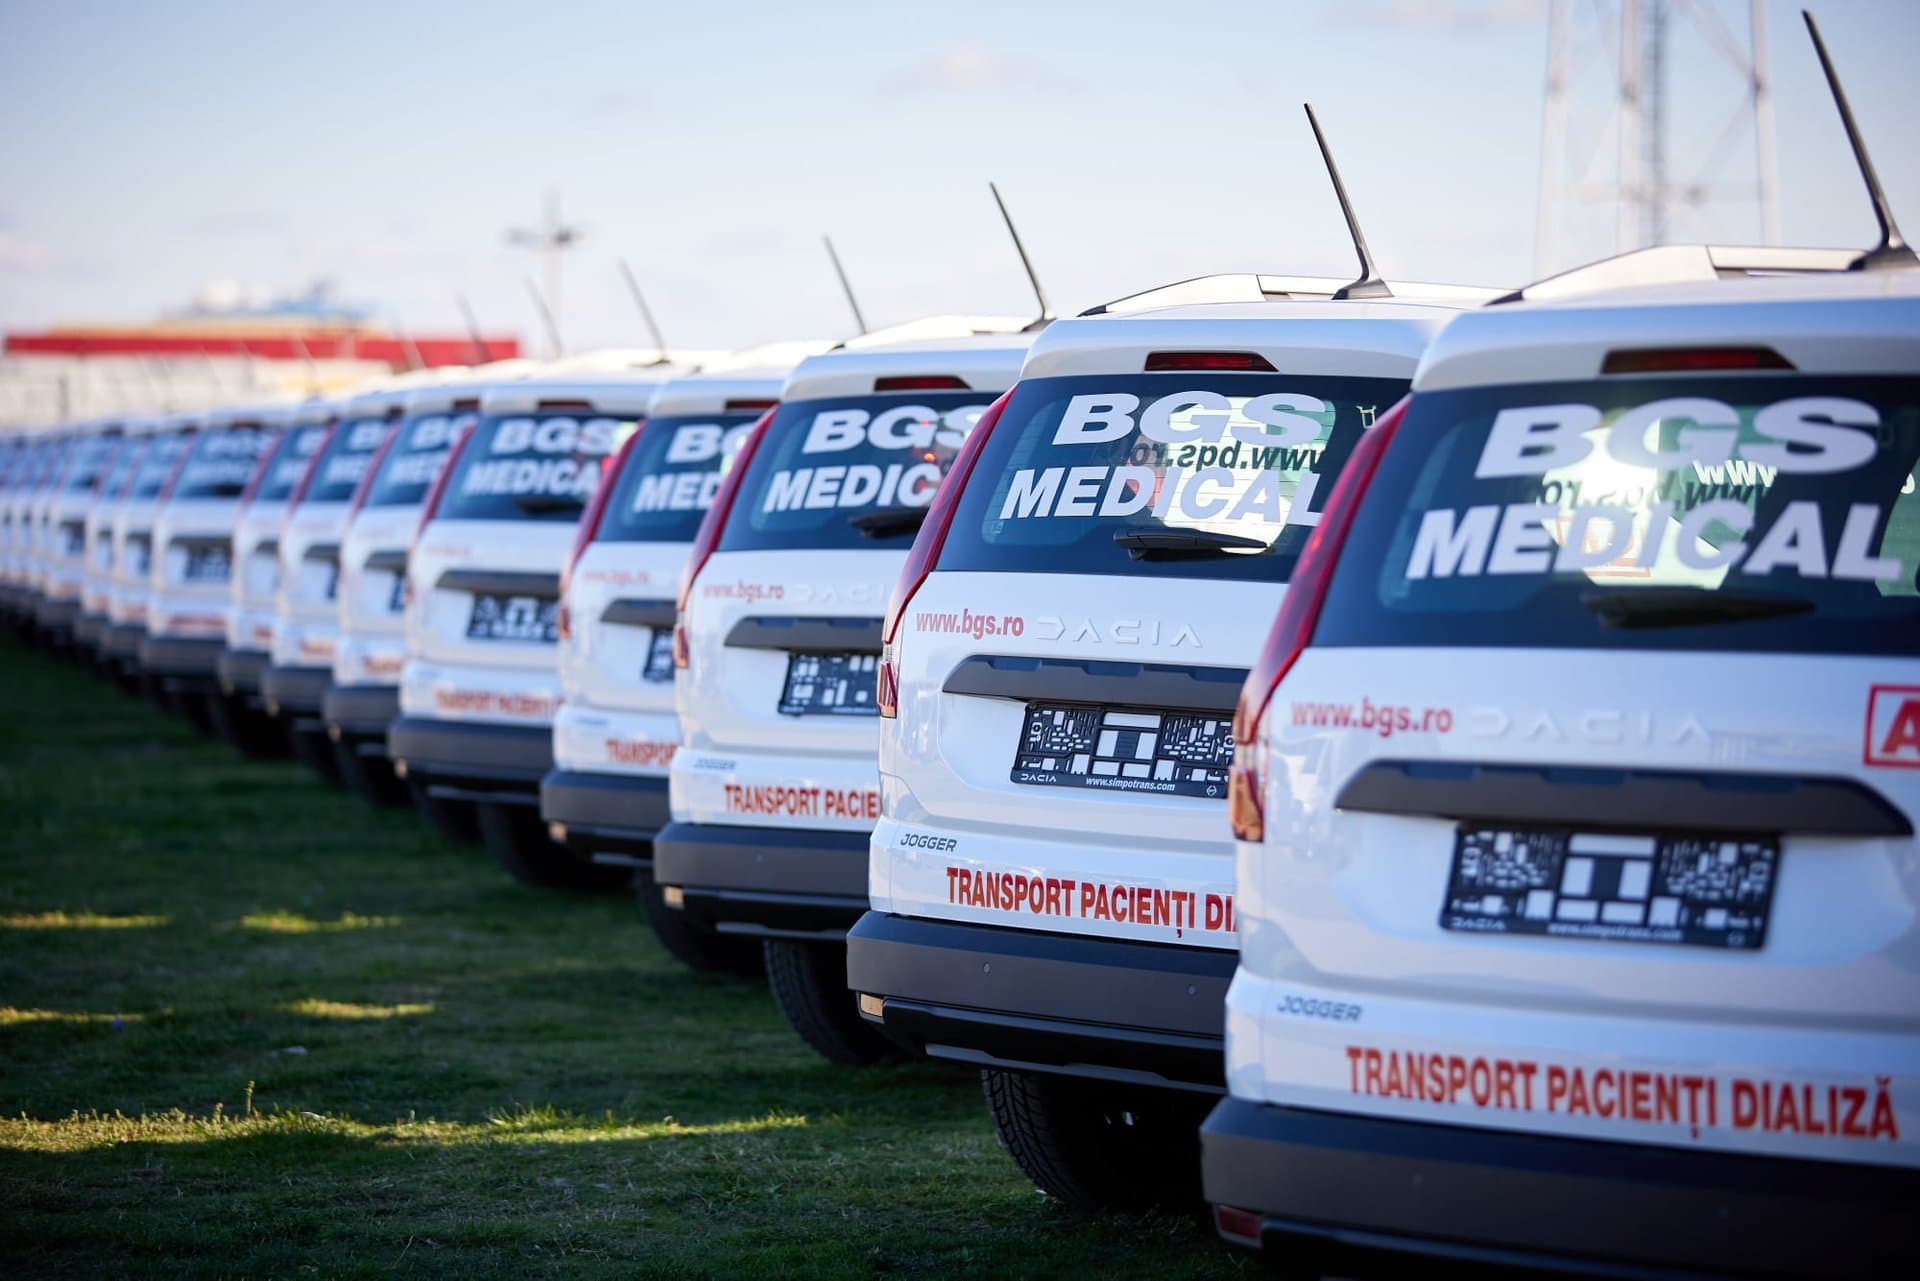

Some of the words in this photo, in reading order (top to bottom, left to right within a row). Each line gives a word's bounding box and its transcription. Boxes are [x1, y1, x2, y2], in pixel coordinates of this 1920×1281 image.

[1052, 391, 1326, 446] BGS
[1475, 397, 1881, 480] BGS
[1000, 464, 1325, 527] MEDICAL
[1405, 502, 1901, 581] MEDICAL
[916, 608, 1024, 641] www.bgs.ro
[1036, 615, 1204, 649] DACIA
[1290, 696, 1453, 739] www.bgs.ro
[1020, 773, 1057, 783] DACIA
[1085, 776, 1176, 792] www.simpotrans.com
[724, 784, 820, 816] TRANSPORT
[825, 789, 884, 818] PACIE
[901, 833, 957, 853] JOGGER
[946, 866, 1076, 917] TRANSPORT
[1081, 880, 1196, 939] PACIENȚI
[1276, 995, 1363, 1023] JOGGER
[1345, 1045, 1538, 1112] TRANSPORT
[1545, 1065, 1717, 1139] PACIENȚI
[1731, 1076, 1899, 1140] DIALIZĂ
